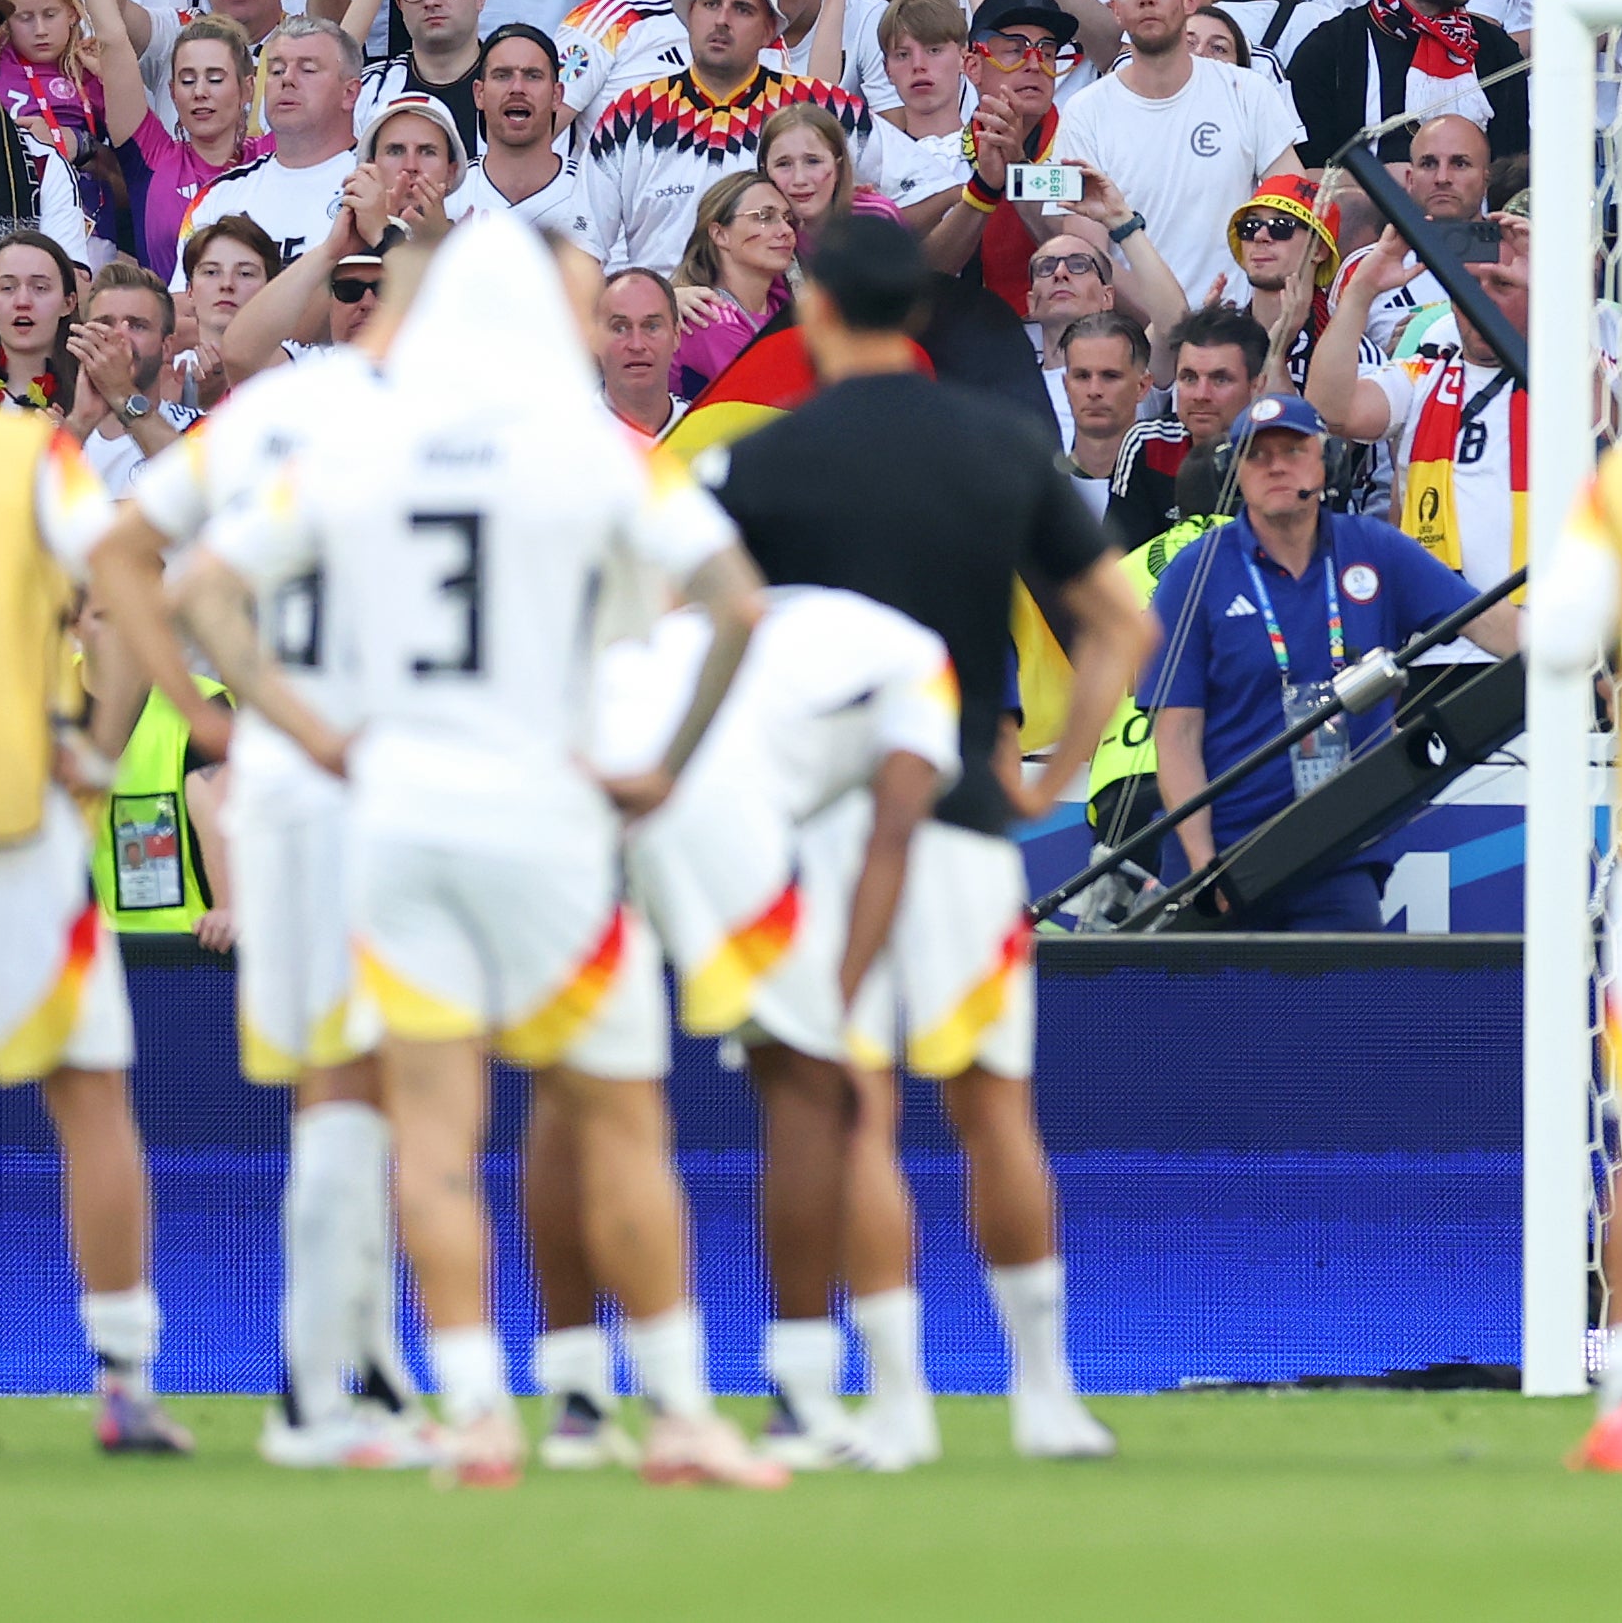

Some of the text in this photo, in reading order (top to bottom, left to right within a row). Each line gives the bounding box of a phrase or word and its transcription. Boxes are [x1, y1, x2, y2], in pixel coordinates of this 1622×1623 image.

[655, 183, 696, 199] adidas
[1049, 168, 1062, 198] 1899
[408, 511, 486, 679] 3
